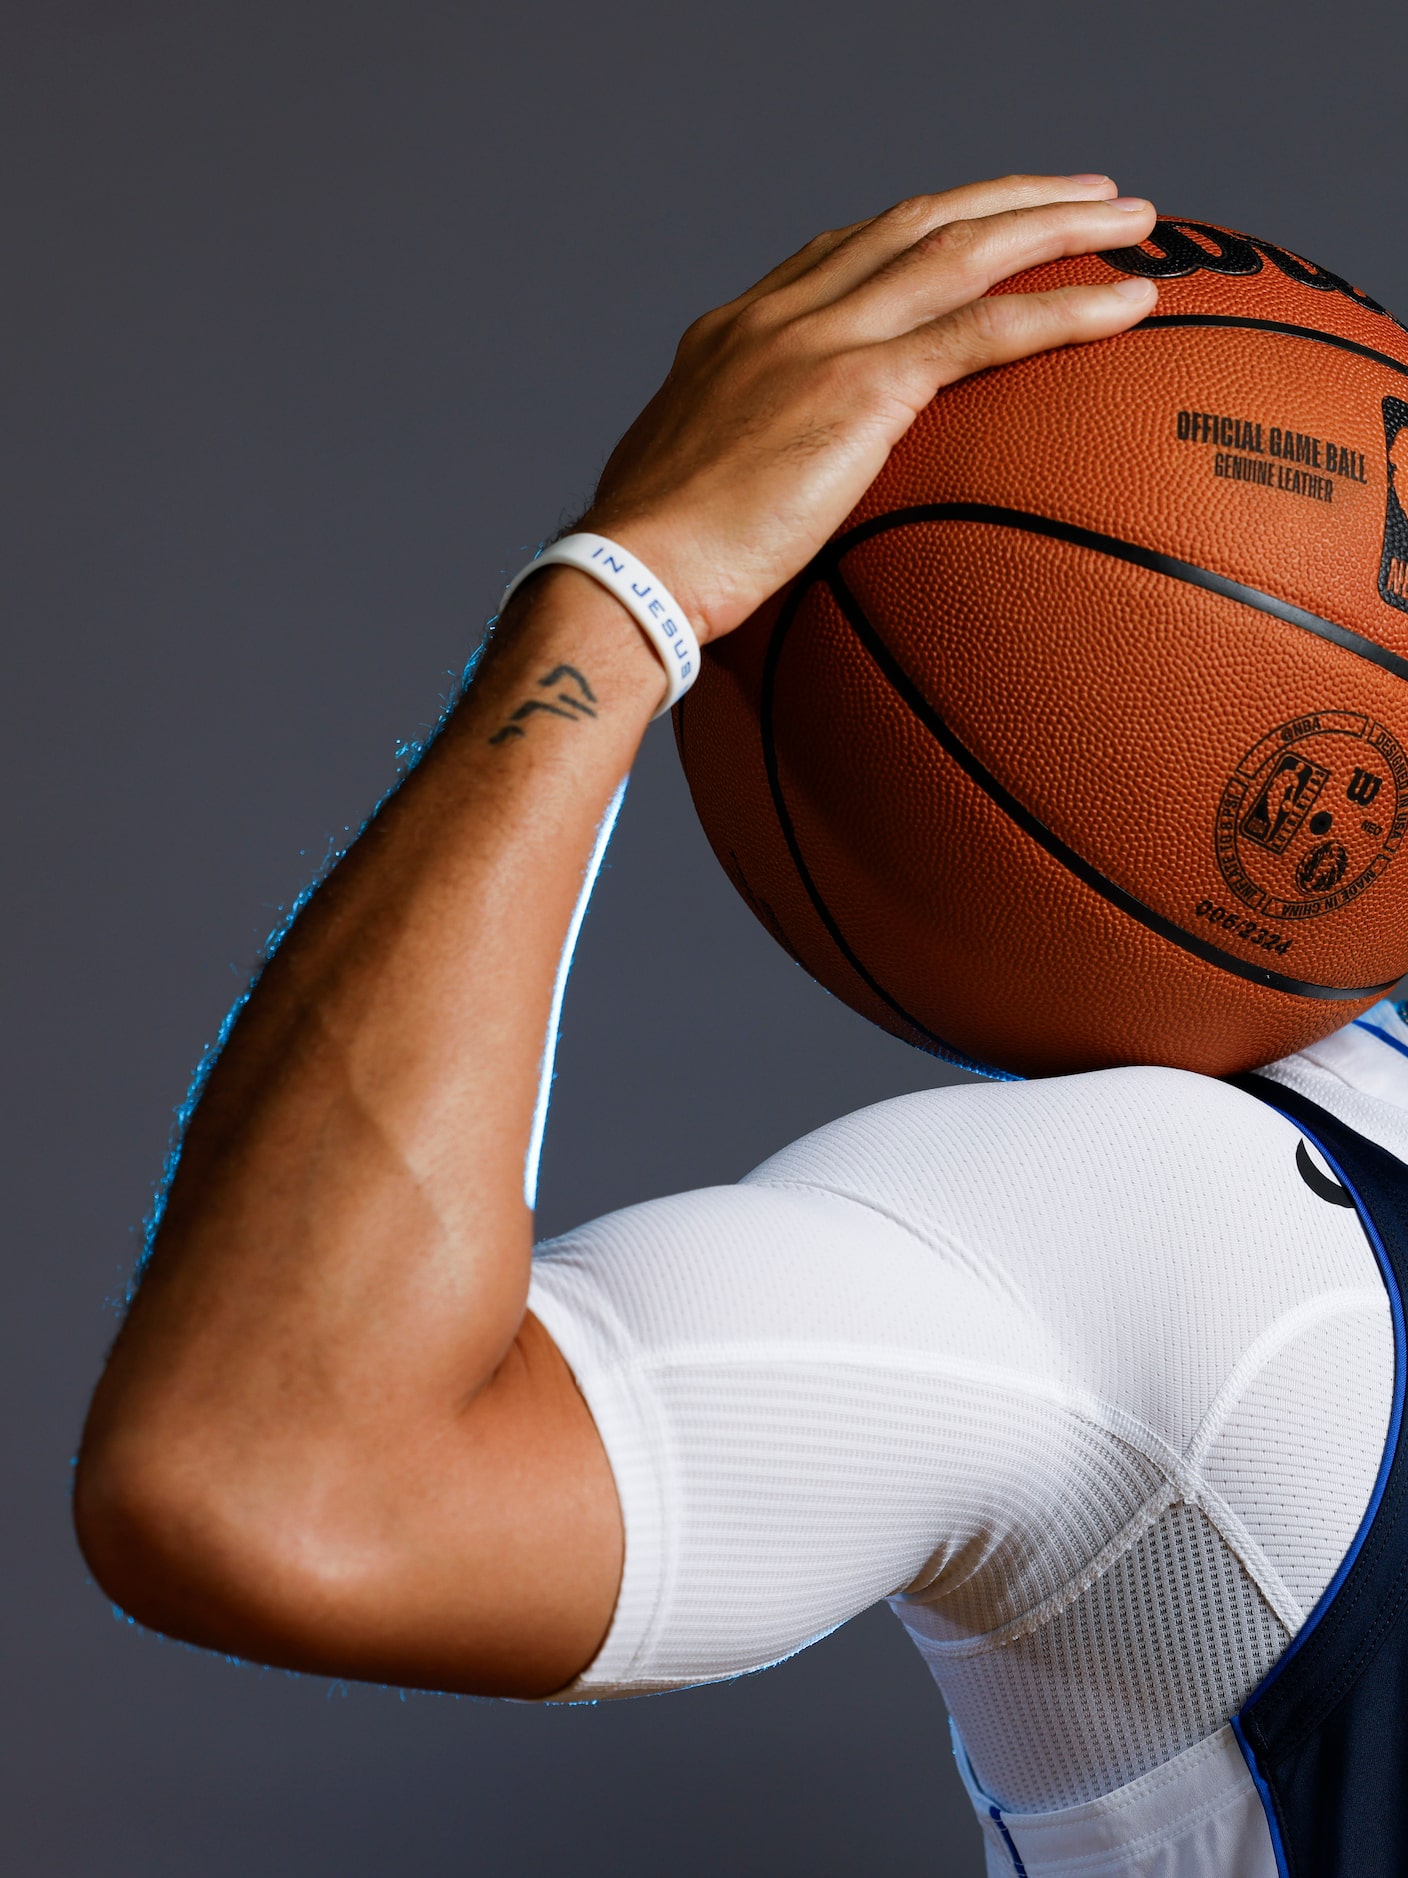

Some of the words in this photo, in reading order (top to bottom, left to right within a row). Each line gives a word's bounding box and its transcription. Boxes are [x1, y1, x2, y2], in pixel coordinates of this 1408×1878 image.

[1177, 410, 1264, 454] OFFICIAL
[1269, 426, 1321, 469] GAME
[1326, 442, 1367, 484] BALL
[1214, 452, 1274, 488] GENUINE
[1277, 465, 1334, 503] LEATHER
[591, 547, 625, 573] IN
[631, 582, 692, 679] JESUS
[1281, 716, 1321, 742] @NBA
[1222, 793, 1241, 817] PSI
[1361, 819, 1383, 837] NEO
[1391, 812, 1408, 839] USA
[1220, 835, 1233, 853] TO
[1222, 856, 1258, 899] INFLATE
[1341, 868, 1377, 901] MADE
[1281, 902, 1320, 917] CHINA
[1324, 895, 1338, 910] IN
[1195, 900, 1293, 955] 006/2324
